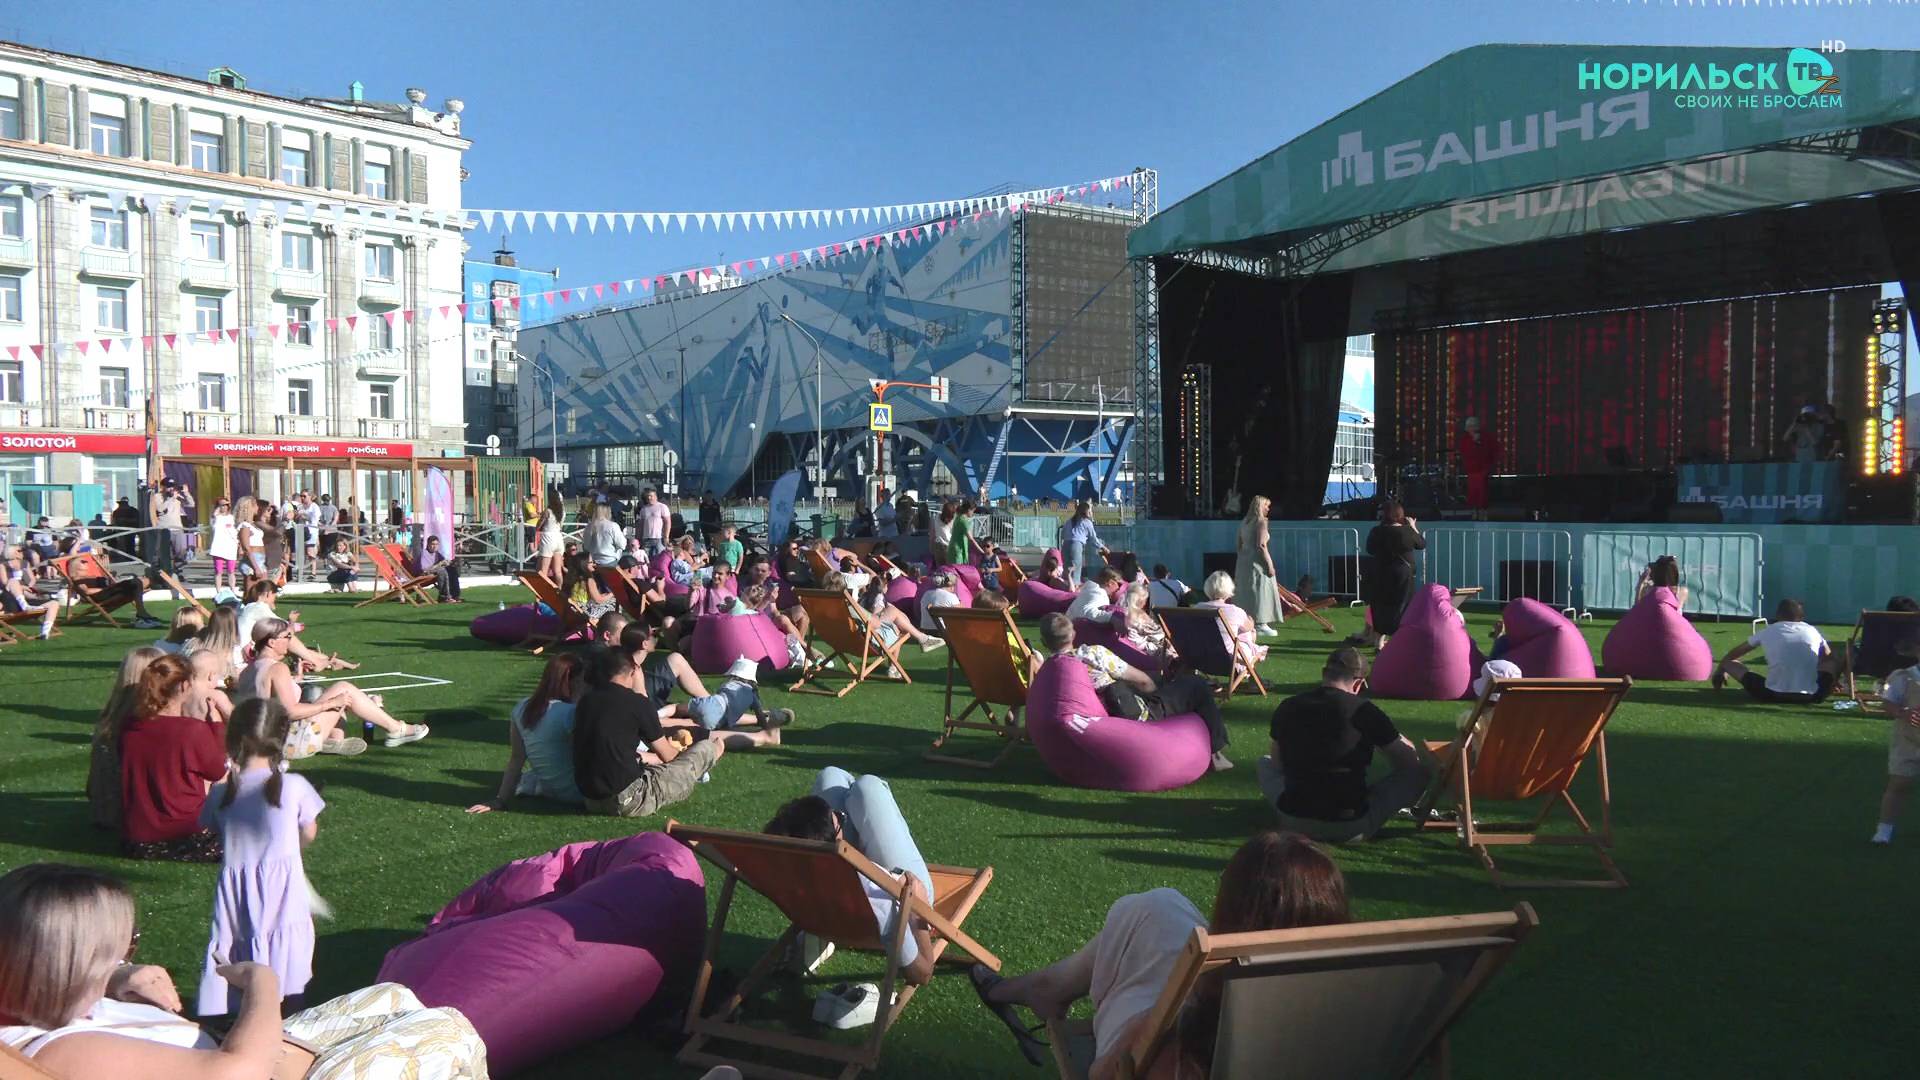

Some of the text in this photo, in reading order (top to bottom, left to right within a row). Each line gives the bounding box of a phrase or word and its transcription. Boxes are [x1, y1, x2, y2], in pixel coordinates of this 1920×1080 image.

[1384, 90, 1651, 182] БАШНЯ
[214, 443, 274, 452] ювелирный
[347, 446, 388, 455] ломбард
